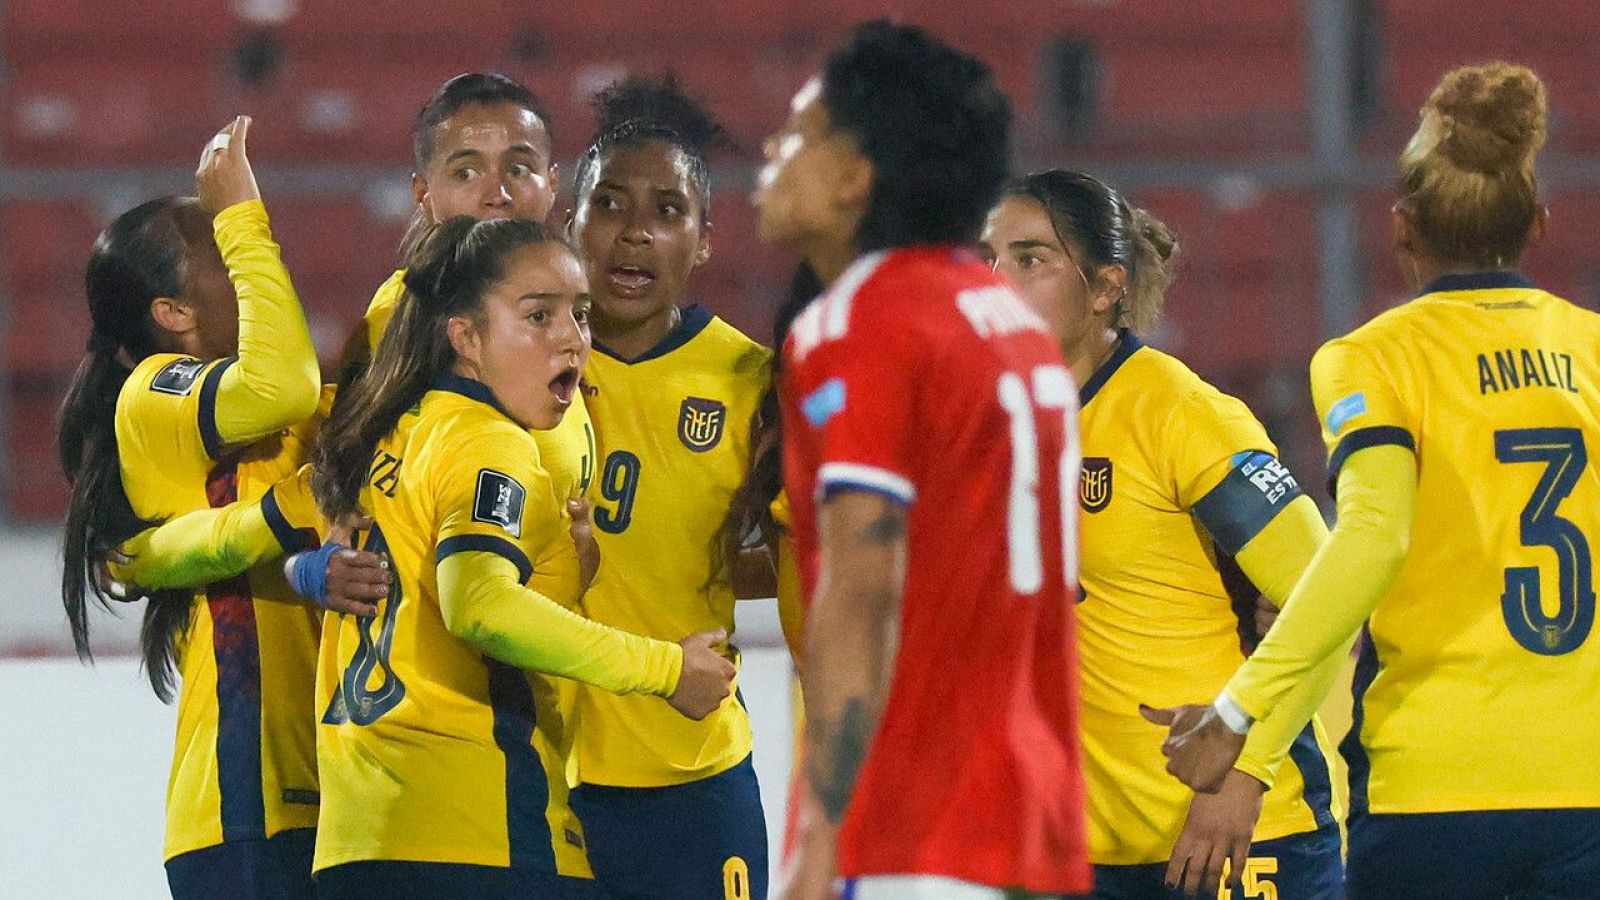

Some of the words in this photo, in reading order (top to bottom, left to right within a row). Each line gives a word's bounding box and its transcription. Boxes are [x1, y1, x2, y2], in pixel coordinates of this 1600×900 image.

[1477, 348, 1579, 395] ANALIZ
[593, 449, 642, 535] 9
[1240, 461, 1258, 477] EL
[1493, 427, 1596, 656] 3
